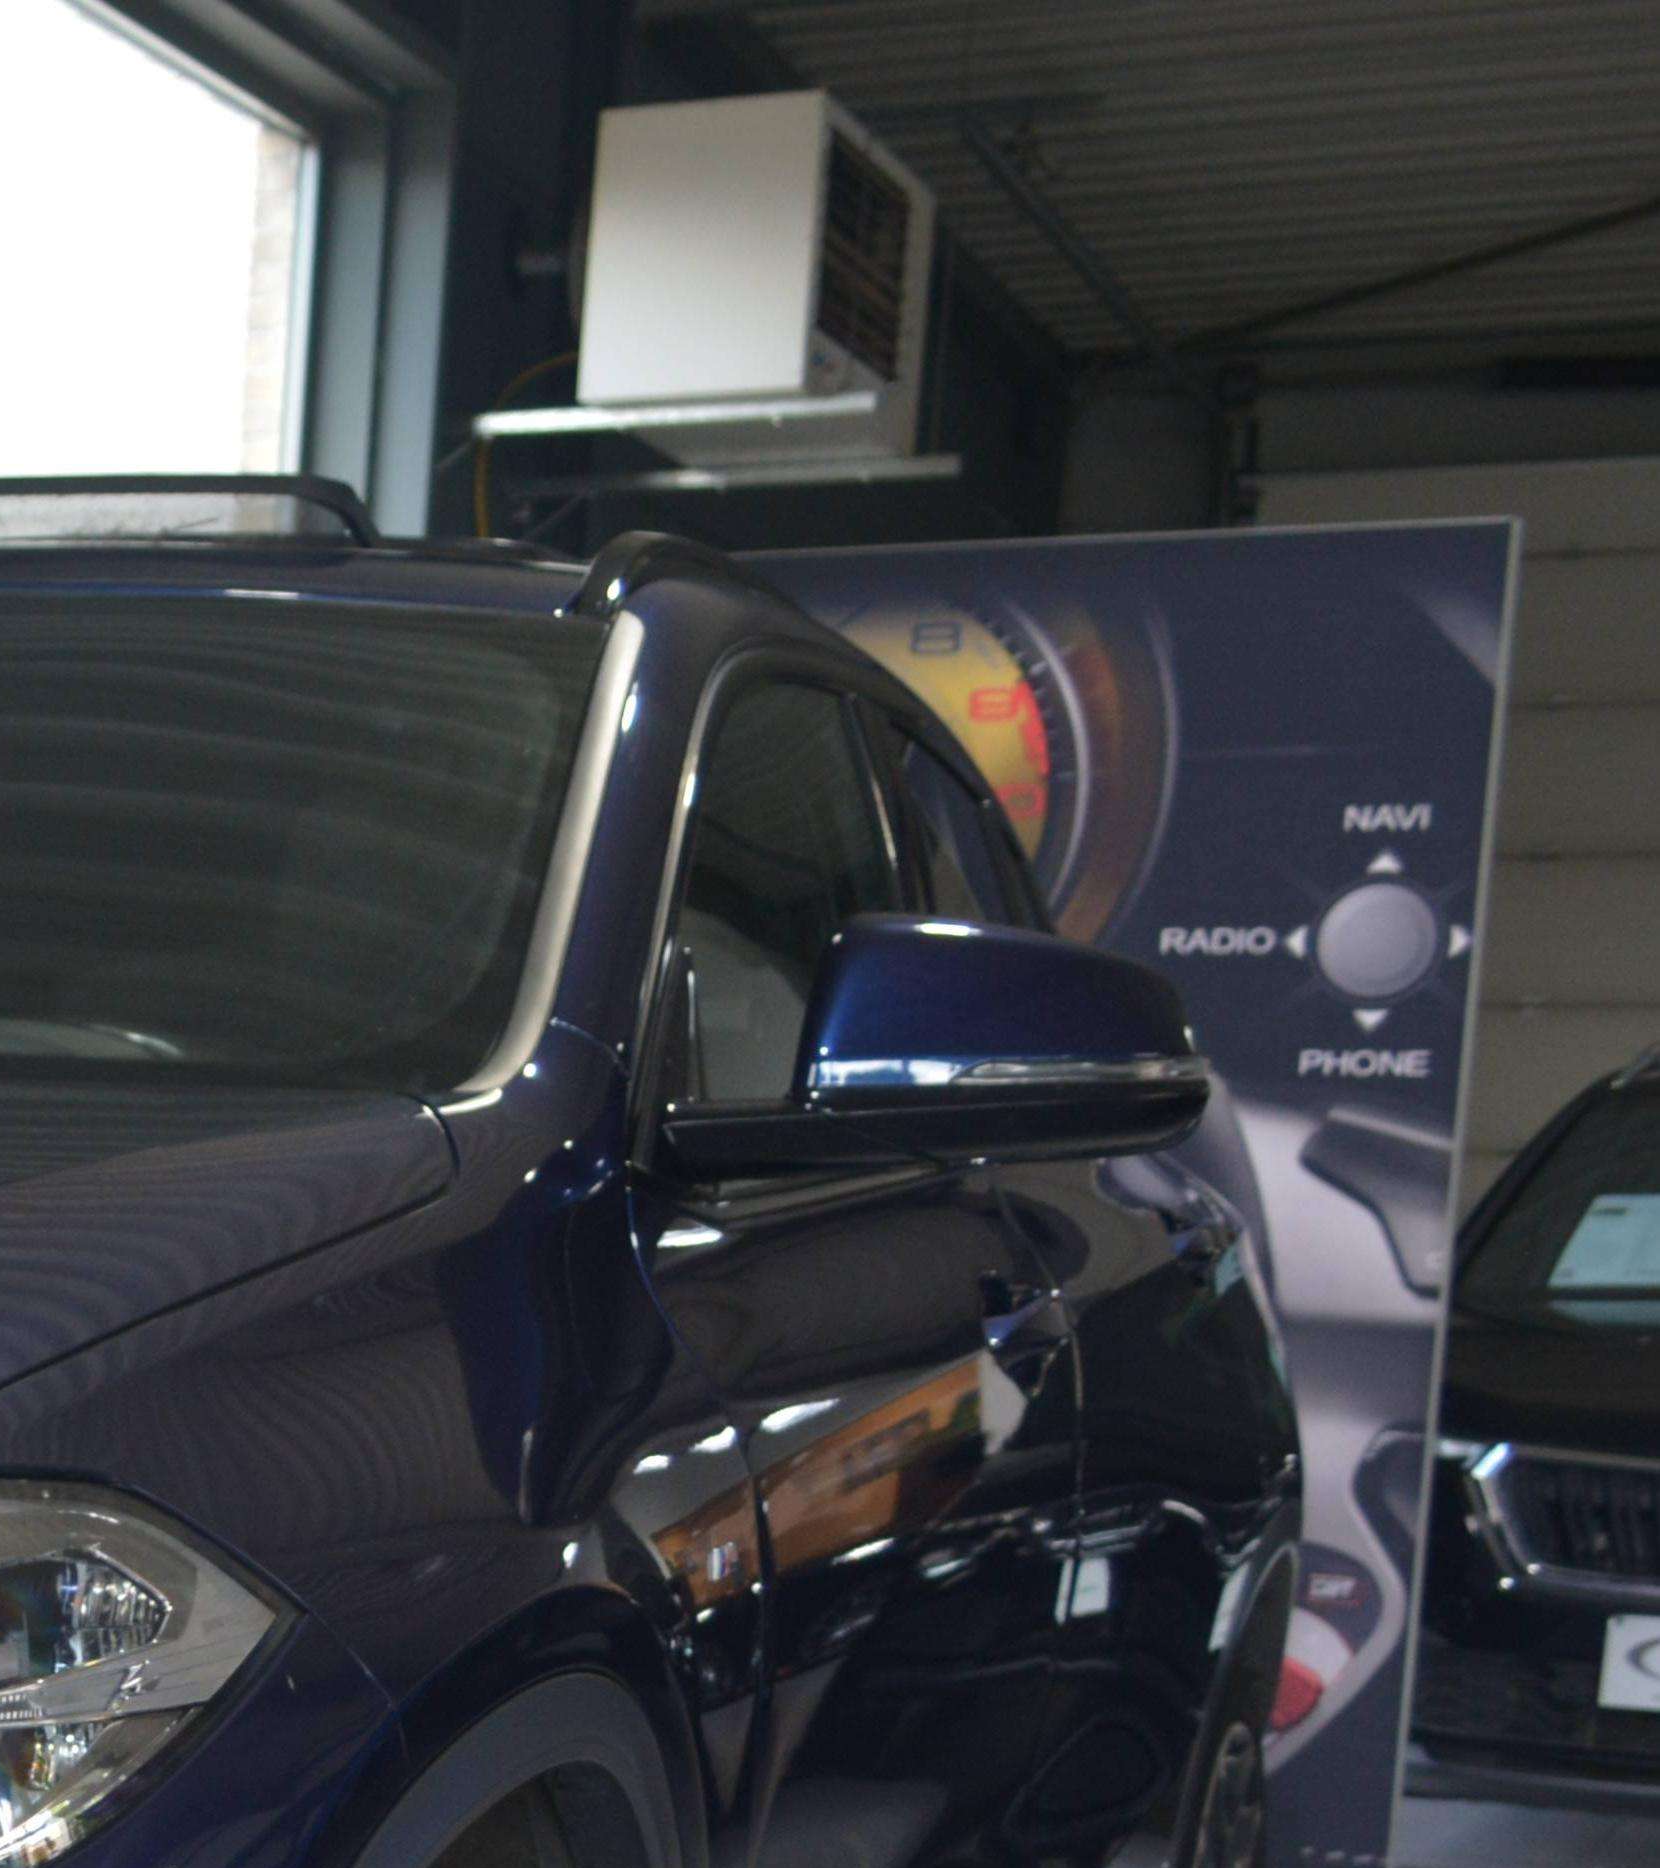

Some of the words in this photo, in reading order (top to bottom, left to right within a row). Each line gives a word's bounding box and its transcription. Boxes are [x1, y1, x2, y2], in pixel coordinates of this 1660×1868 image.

[1343, 803, 1431, 831] NAVI
[1160, 926, 1277, 955] RADIO
[1298, 1049, 1430, 1077] PHONE
